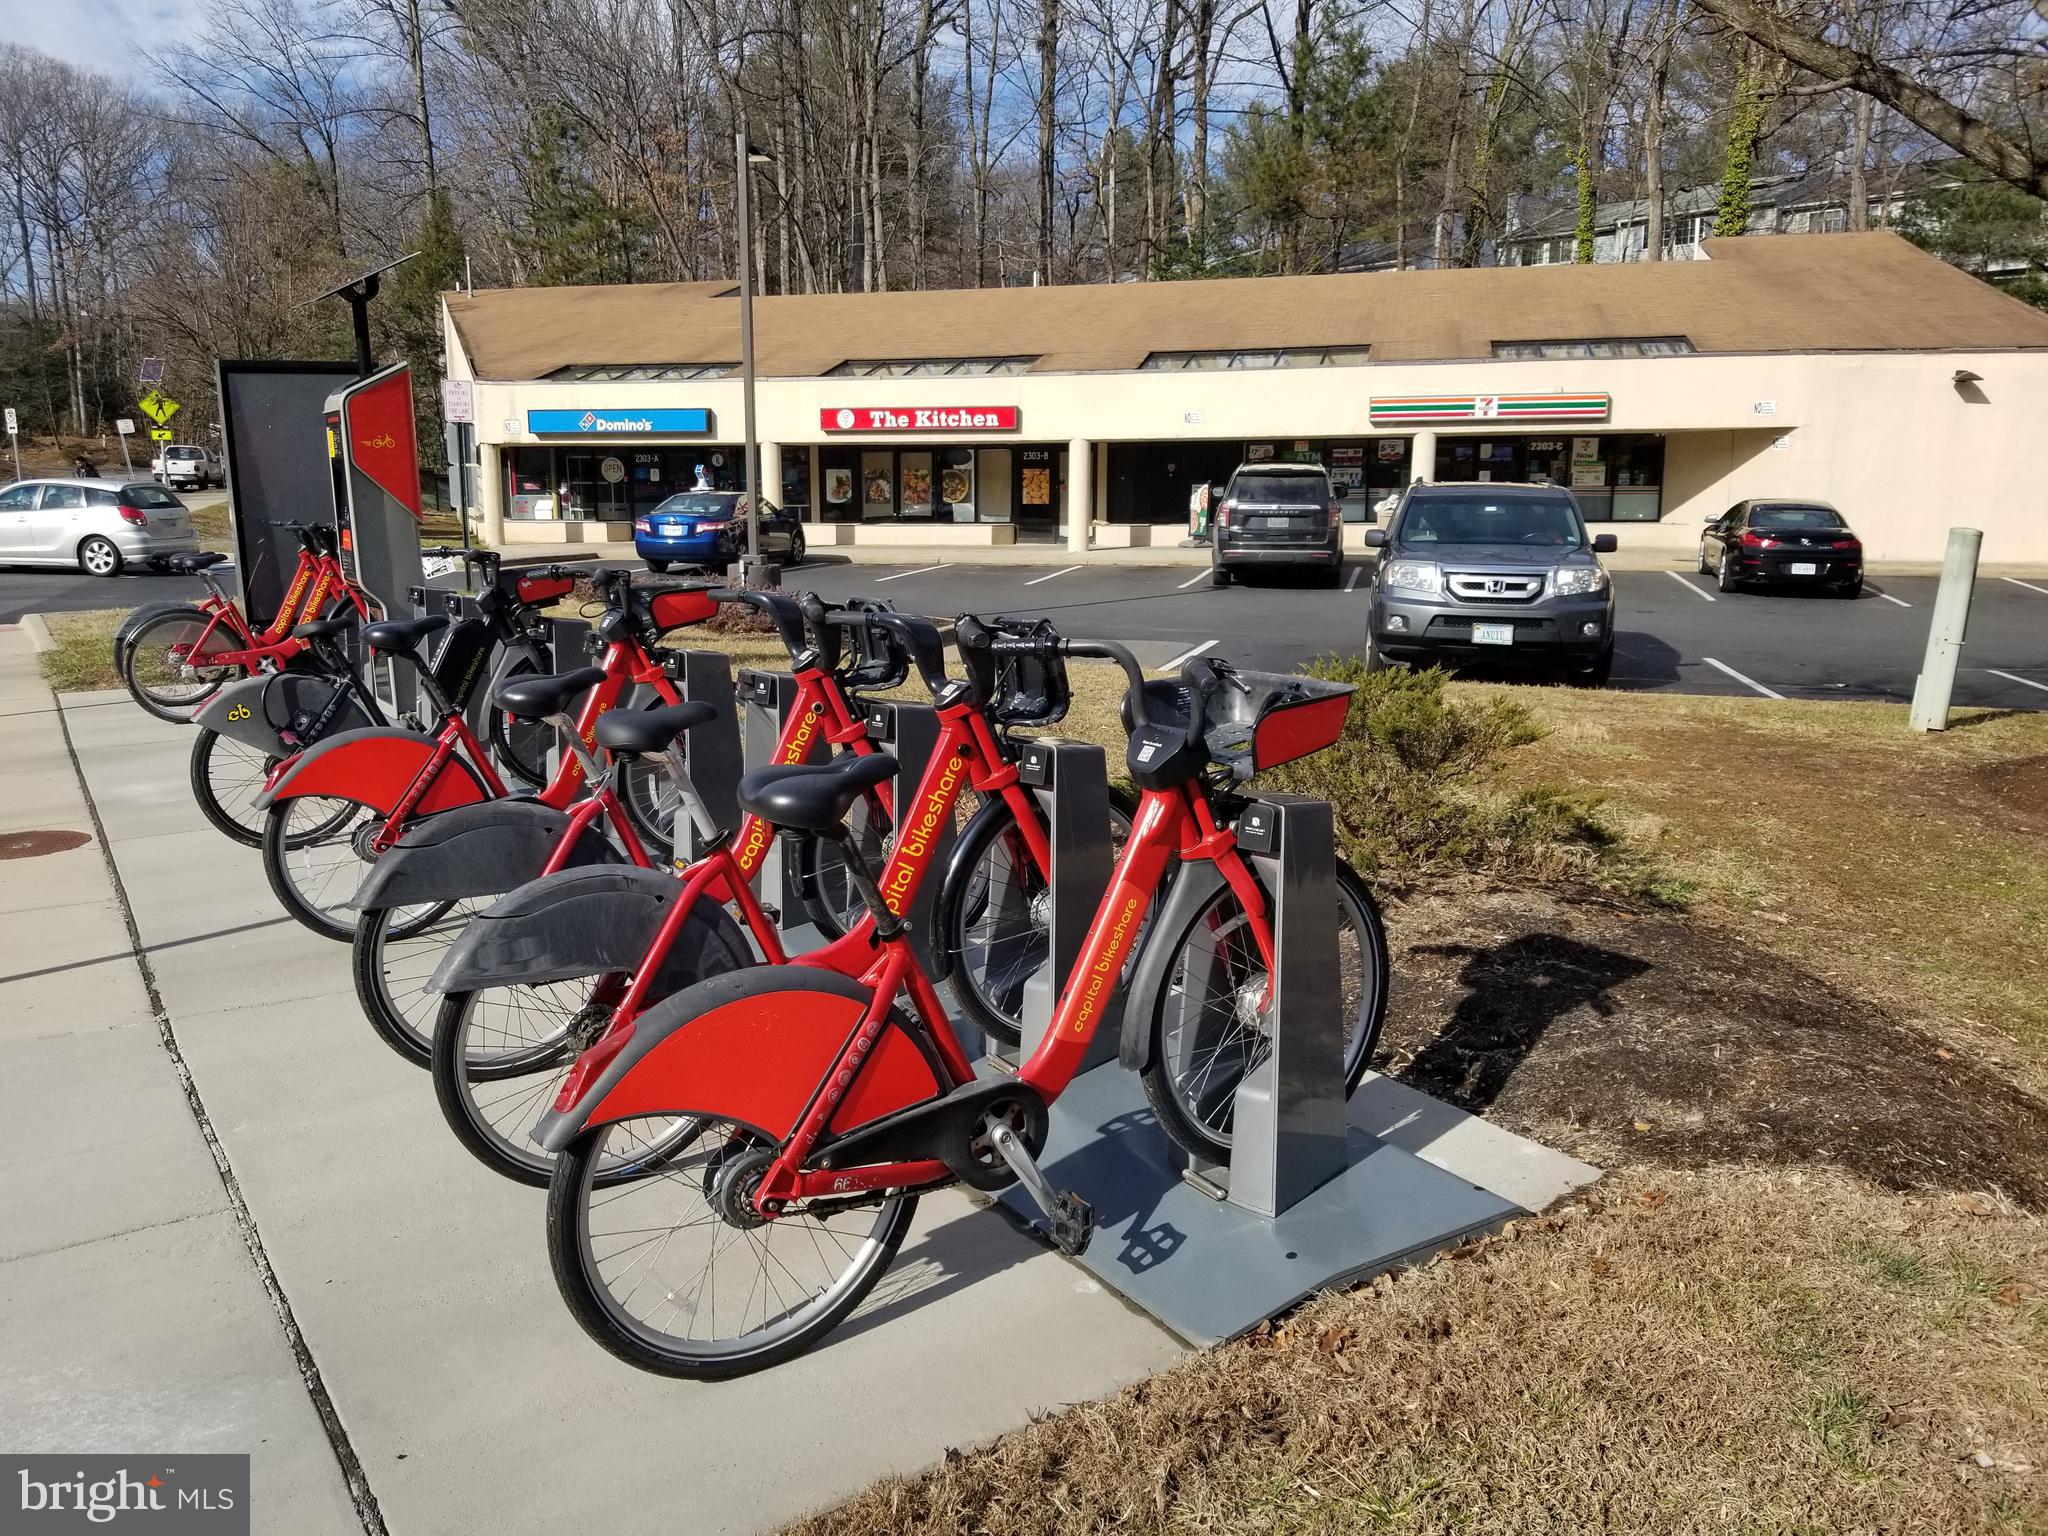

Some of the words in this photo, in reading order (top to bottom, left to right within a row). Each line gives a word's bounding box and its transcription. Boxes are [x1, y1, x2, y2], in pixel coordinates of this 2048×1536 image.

[596, 418, 652, 432] Domino's
[870, 411, 909, 428] The
[915, 409, 1000, 427] Kitchen
[1530, 441, 1564, 451] 2303-C
[635, 454, 659, 463] 2303-A
[1023, 452, 1049, 460] 2303-B
[1296, 452, 1322, 463] ATM
[603, 462, 622, 473] OPEN
[305, 575, 330, 613] bikeshare
[275, 606, 292, 634] capital
[286, 570, 310, 606] bikeshare
[886, 861, 915, 915] pital
[901, 756, 962, 856] bikeshare
[1074, 975, 1104, 1032] capital
[1095, 898, 1137, 972] bikeshare
